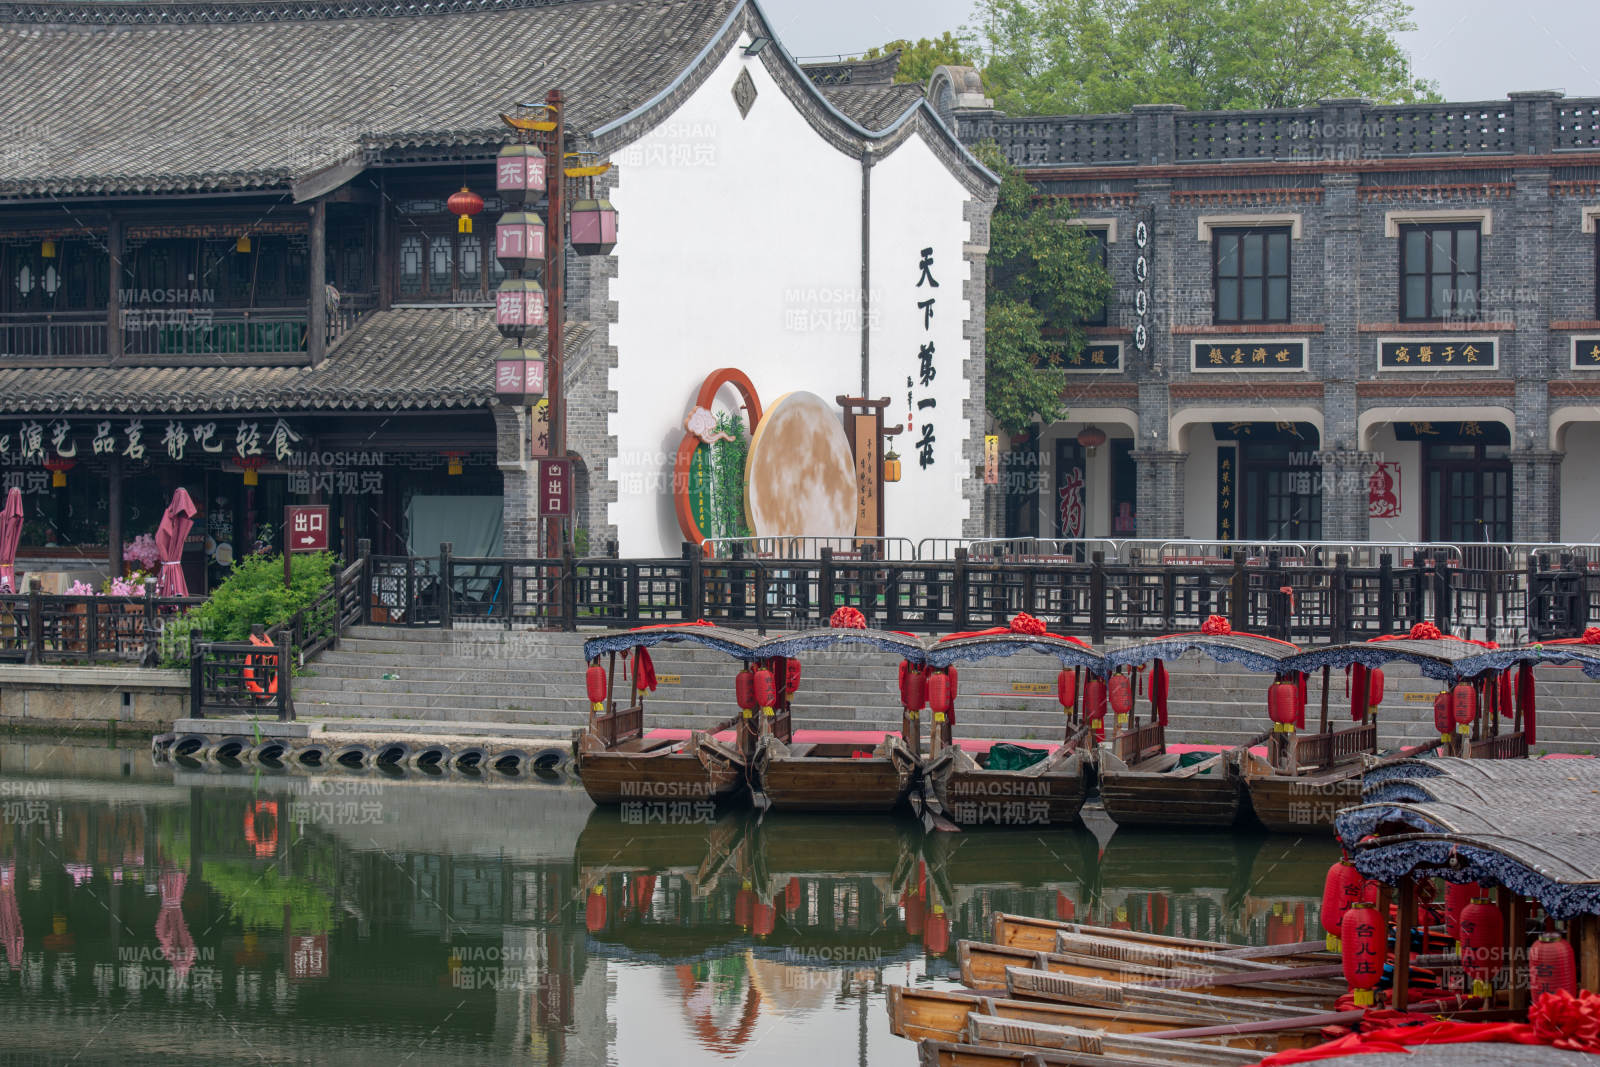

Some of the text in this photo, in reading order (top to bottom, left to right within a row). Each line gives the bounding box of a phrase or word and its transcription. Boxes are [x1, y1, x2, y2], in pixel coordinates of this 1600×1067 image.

[500, 162, 524, 387] 东门码头
[528, 162, 544, 387] 东门码头
[19, 420, 77, 458] 演艺
[92, 418, 146, 460] 品茗
[161, 419, 223, 461] 静吧
[235, 418, 303, 461] 轻食
[548, 480, 562, 511] 出口
[1059, 466, 1083, 538] 药
[295, 512, 322, 532] 出口
[1355, 923, 1377, 975] 台儿庄
